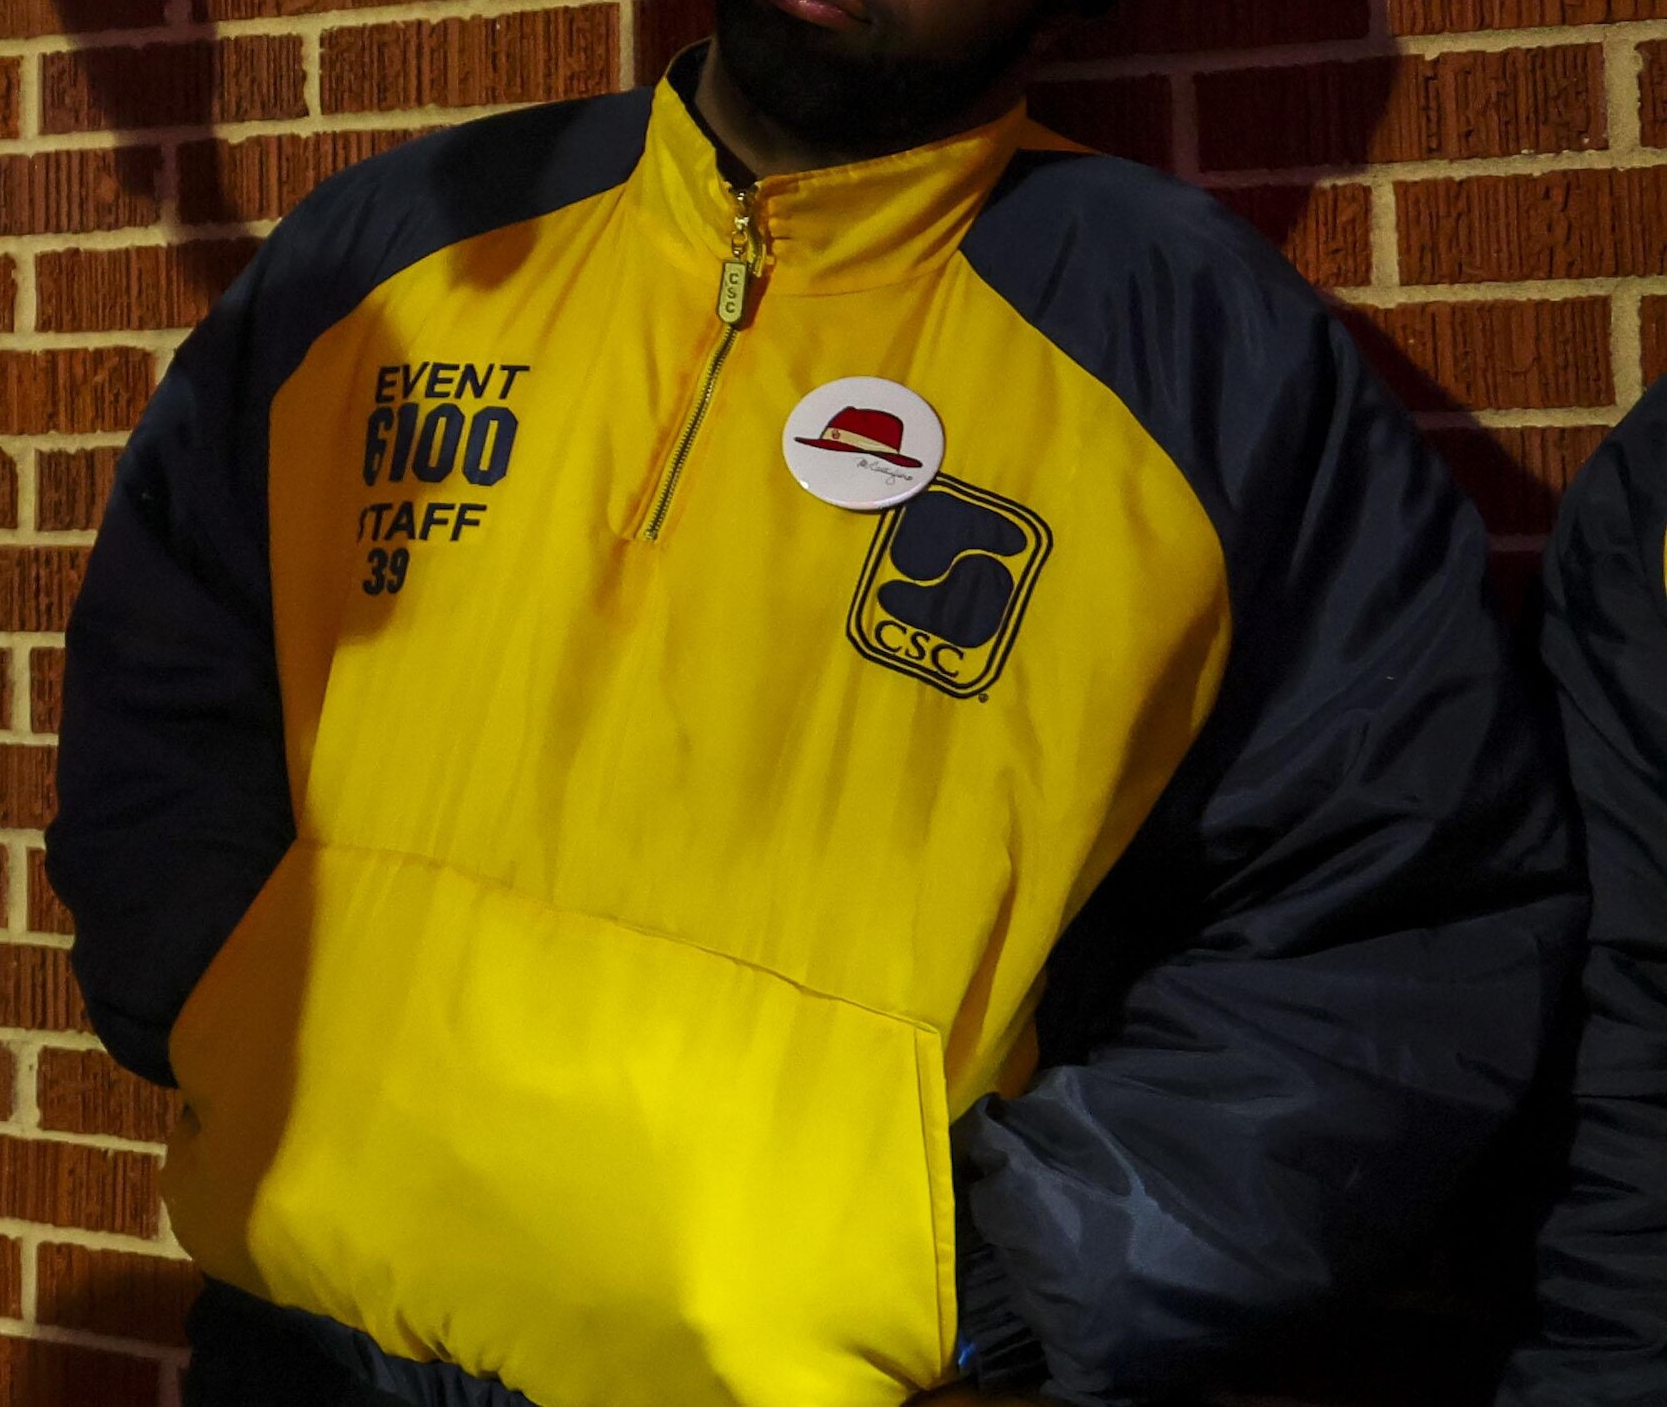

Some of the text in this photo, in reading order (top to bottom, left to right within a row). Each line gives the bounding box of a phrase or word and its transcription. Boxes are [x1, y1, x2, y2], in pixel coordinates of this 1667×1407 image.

[375, 361, 530, 404] EVENT
[363, 402, 519, 487] 6100
[363, 547, 410, 595] 39
[873, 619, 965, 678] CSC
